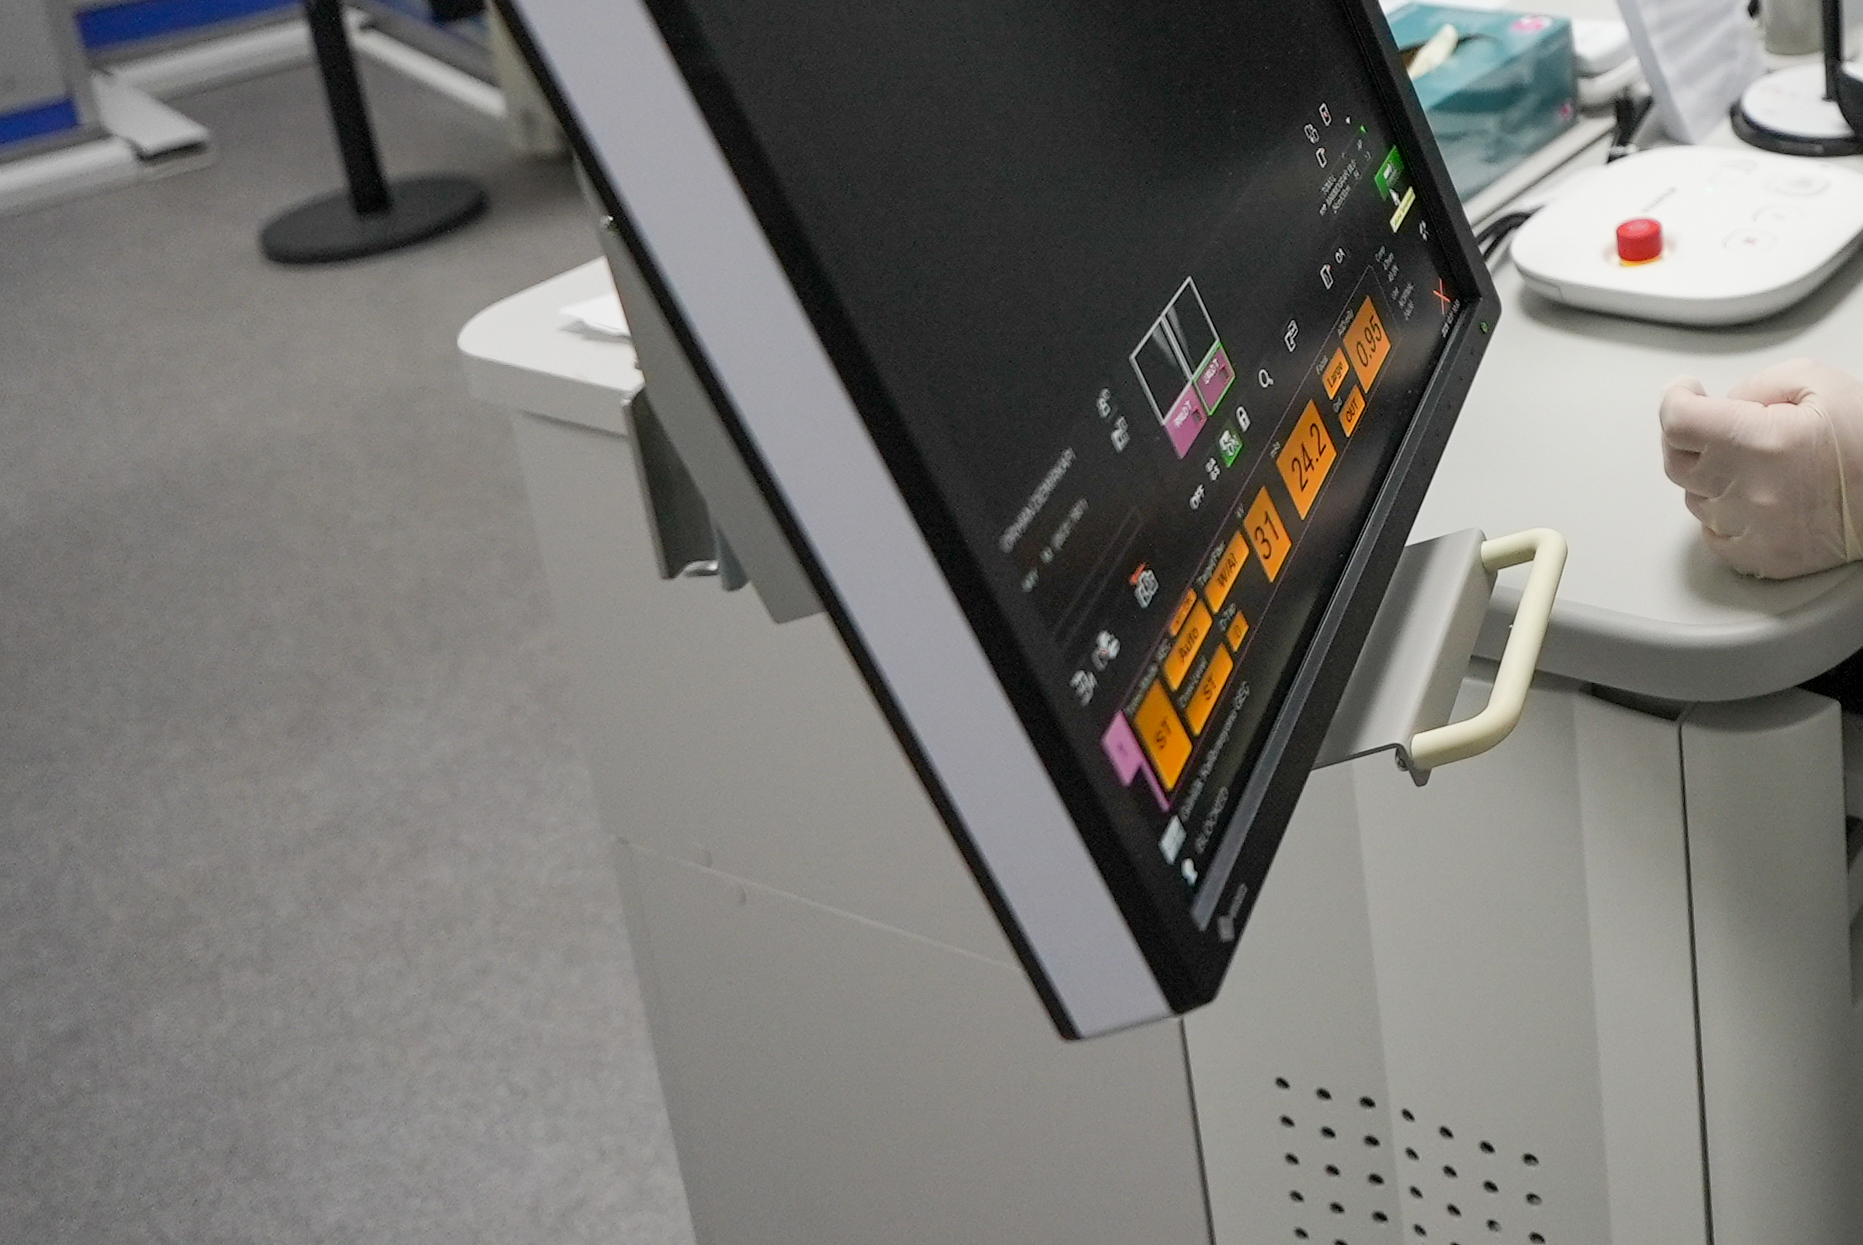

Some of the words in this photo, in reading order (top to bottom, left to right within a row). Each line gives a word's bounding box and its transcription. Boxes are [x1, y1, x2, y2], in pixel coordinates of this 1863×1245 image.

[1356, 315, 1382, 368] 0.95
[1345, 397, 1359, 423] OUT
[1291, 423, 1327, 492] 24.2
[1254, 511, 1280, 560] 31
